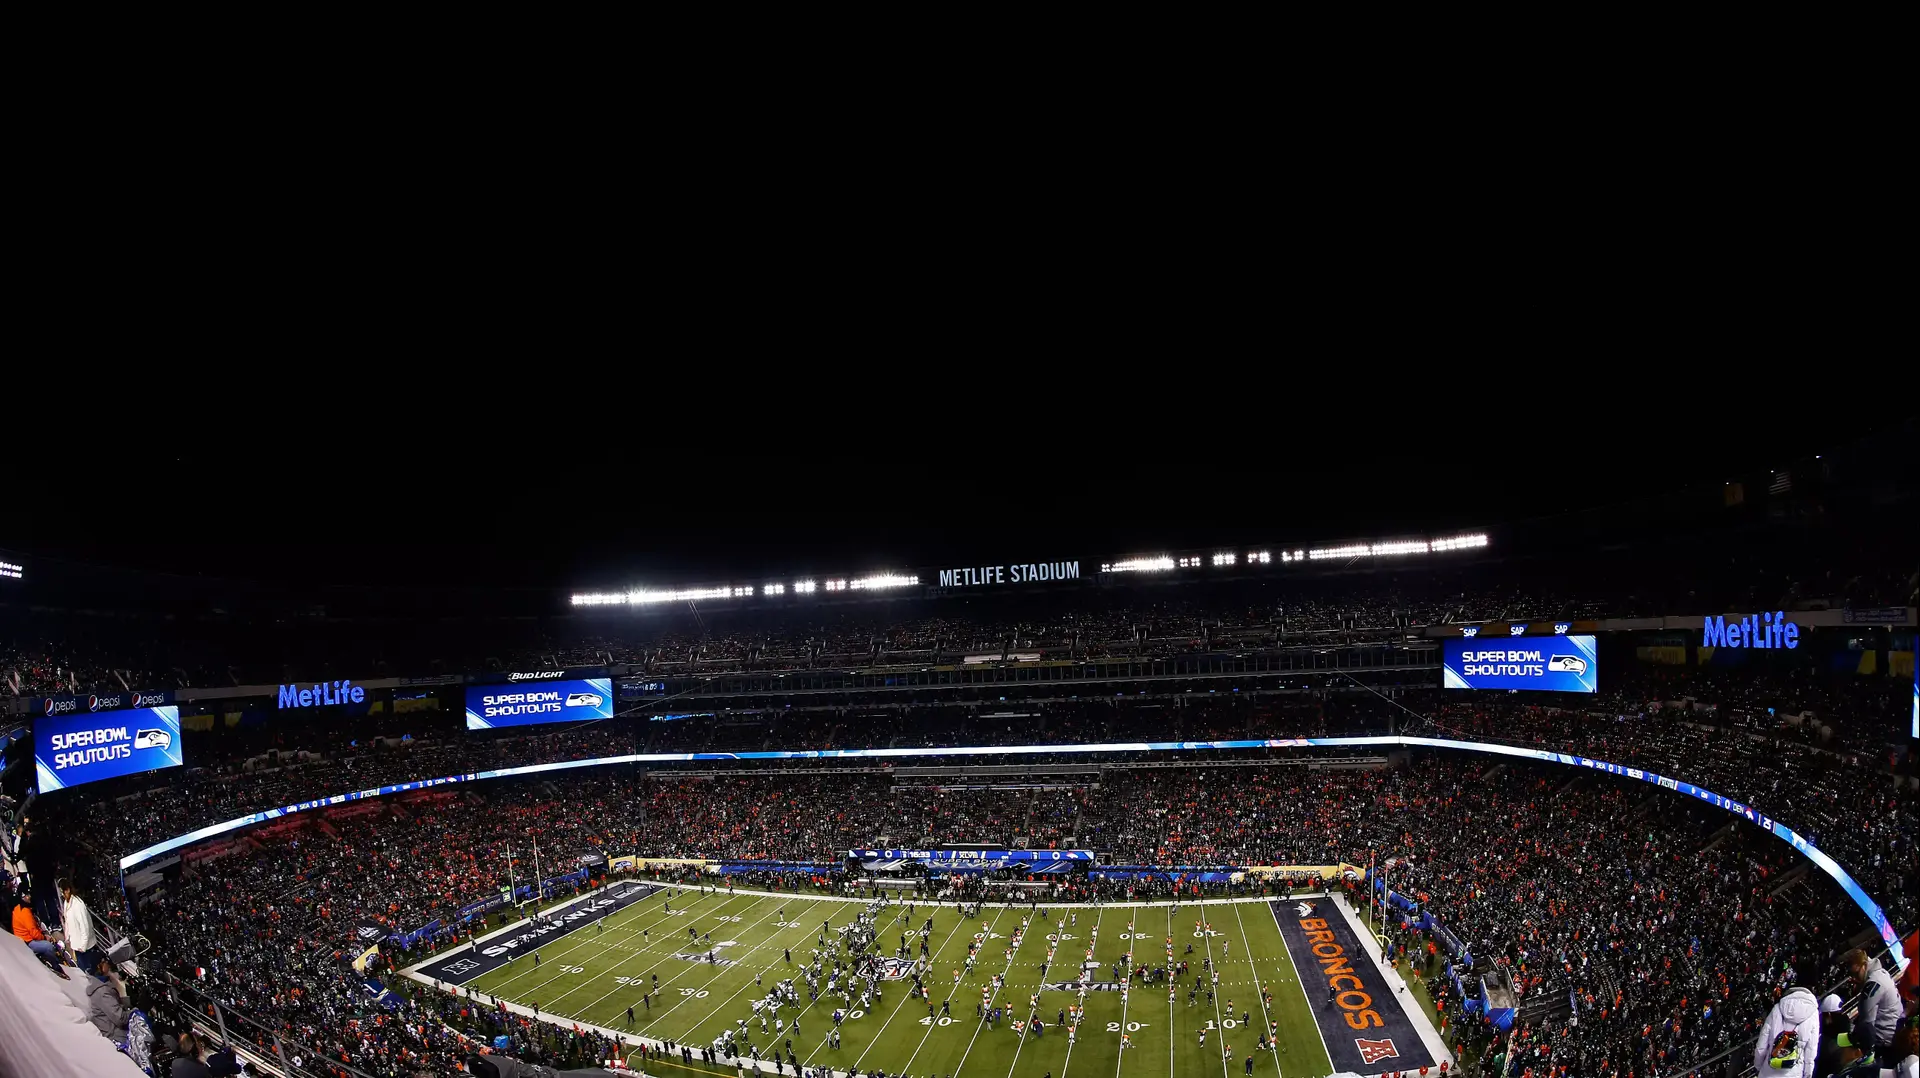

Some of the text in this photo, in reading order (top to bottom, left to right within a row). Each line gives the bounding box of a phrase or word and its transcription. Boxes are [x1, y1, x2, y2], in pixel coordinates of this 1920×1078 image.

[939, 561, 1080, 587] METLIFE STADIUM
[1463, 629, 1477, 637] SAP
[1510, 627, 1524, 636] SAP
[1554, 625, 1568, 634] SAP
[1703, 611, 1799, 649] MetLife
[1462, 650, 1545, 662] SUPER BOWL
[511, 671, 564, 680] BUD LIGHT
[1464, 664, 1544, 676] SHOUTOUTS
[142, 693, 164, 706] pepsi
[279, 680, 364, 709] MetLife
[483, 692, 563, 706] SUPER BOWL
[55, 699, 76, 713] pepsi
[99, 695, 120, 709] pepsi
[485, 703, 561, 717] SHOUTOUTS
[52, 727, 131, 750] SUPER BOWL
[55, 744, 131, 770] SHOUTOUTS
[1299, 918, 1384, 1030] BRONCOS
[919, 1017, 952, 1026] 40
[1107, 1021, 1140, 1032] 20
[1205, 1019, 1237, 1030] 10
